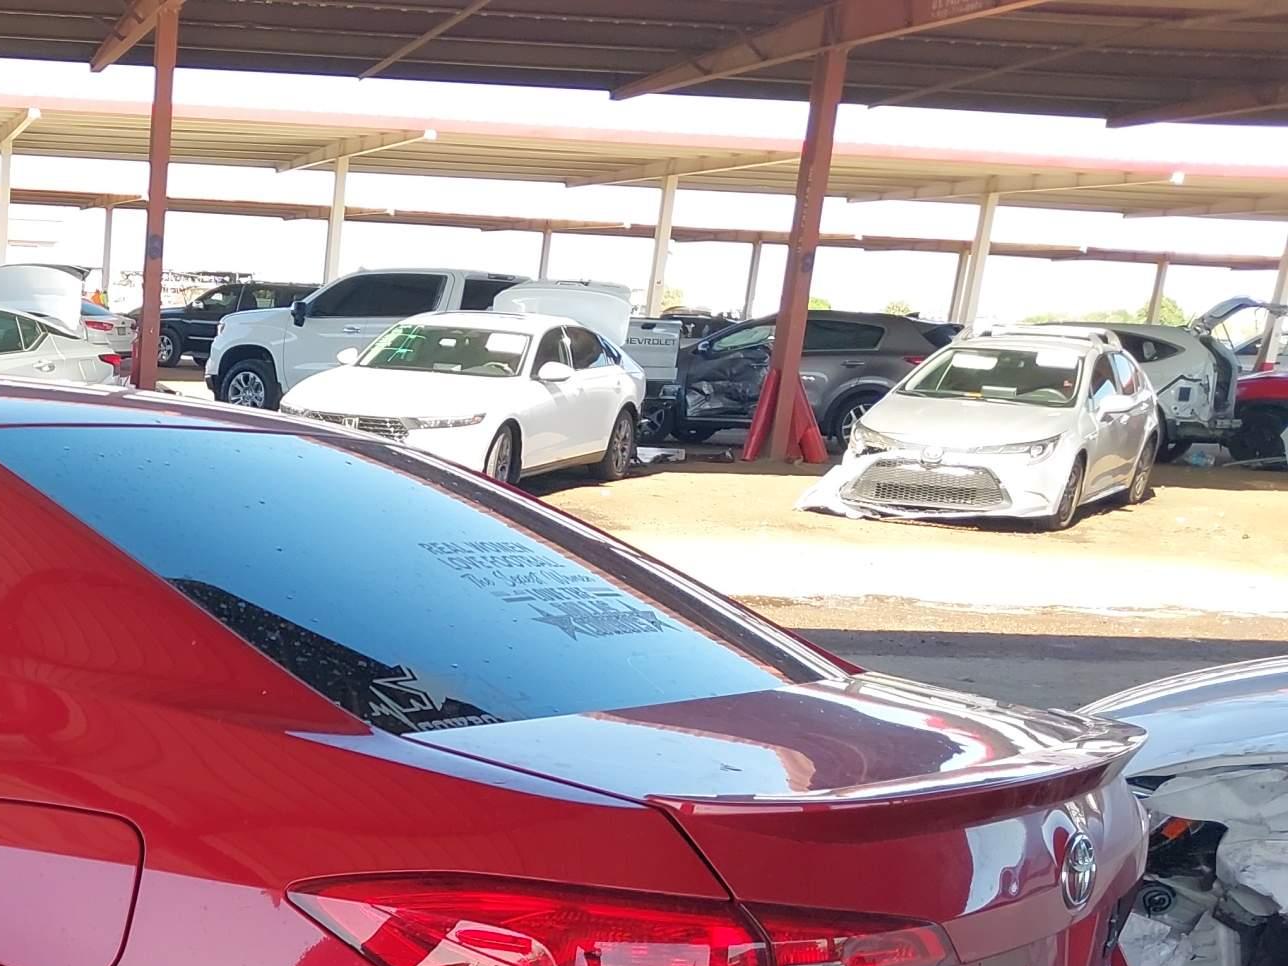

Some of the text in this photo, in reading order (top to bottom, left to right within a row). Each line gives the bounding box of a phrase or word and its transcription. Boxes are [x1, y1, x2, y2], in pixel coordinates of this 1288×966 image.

[626, 337, 676, 346] HEVROLET
[417, 540, 535, 555] REAL WOMEN
[436, 556, 498, 571] LOVE
